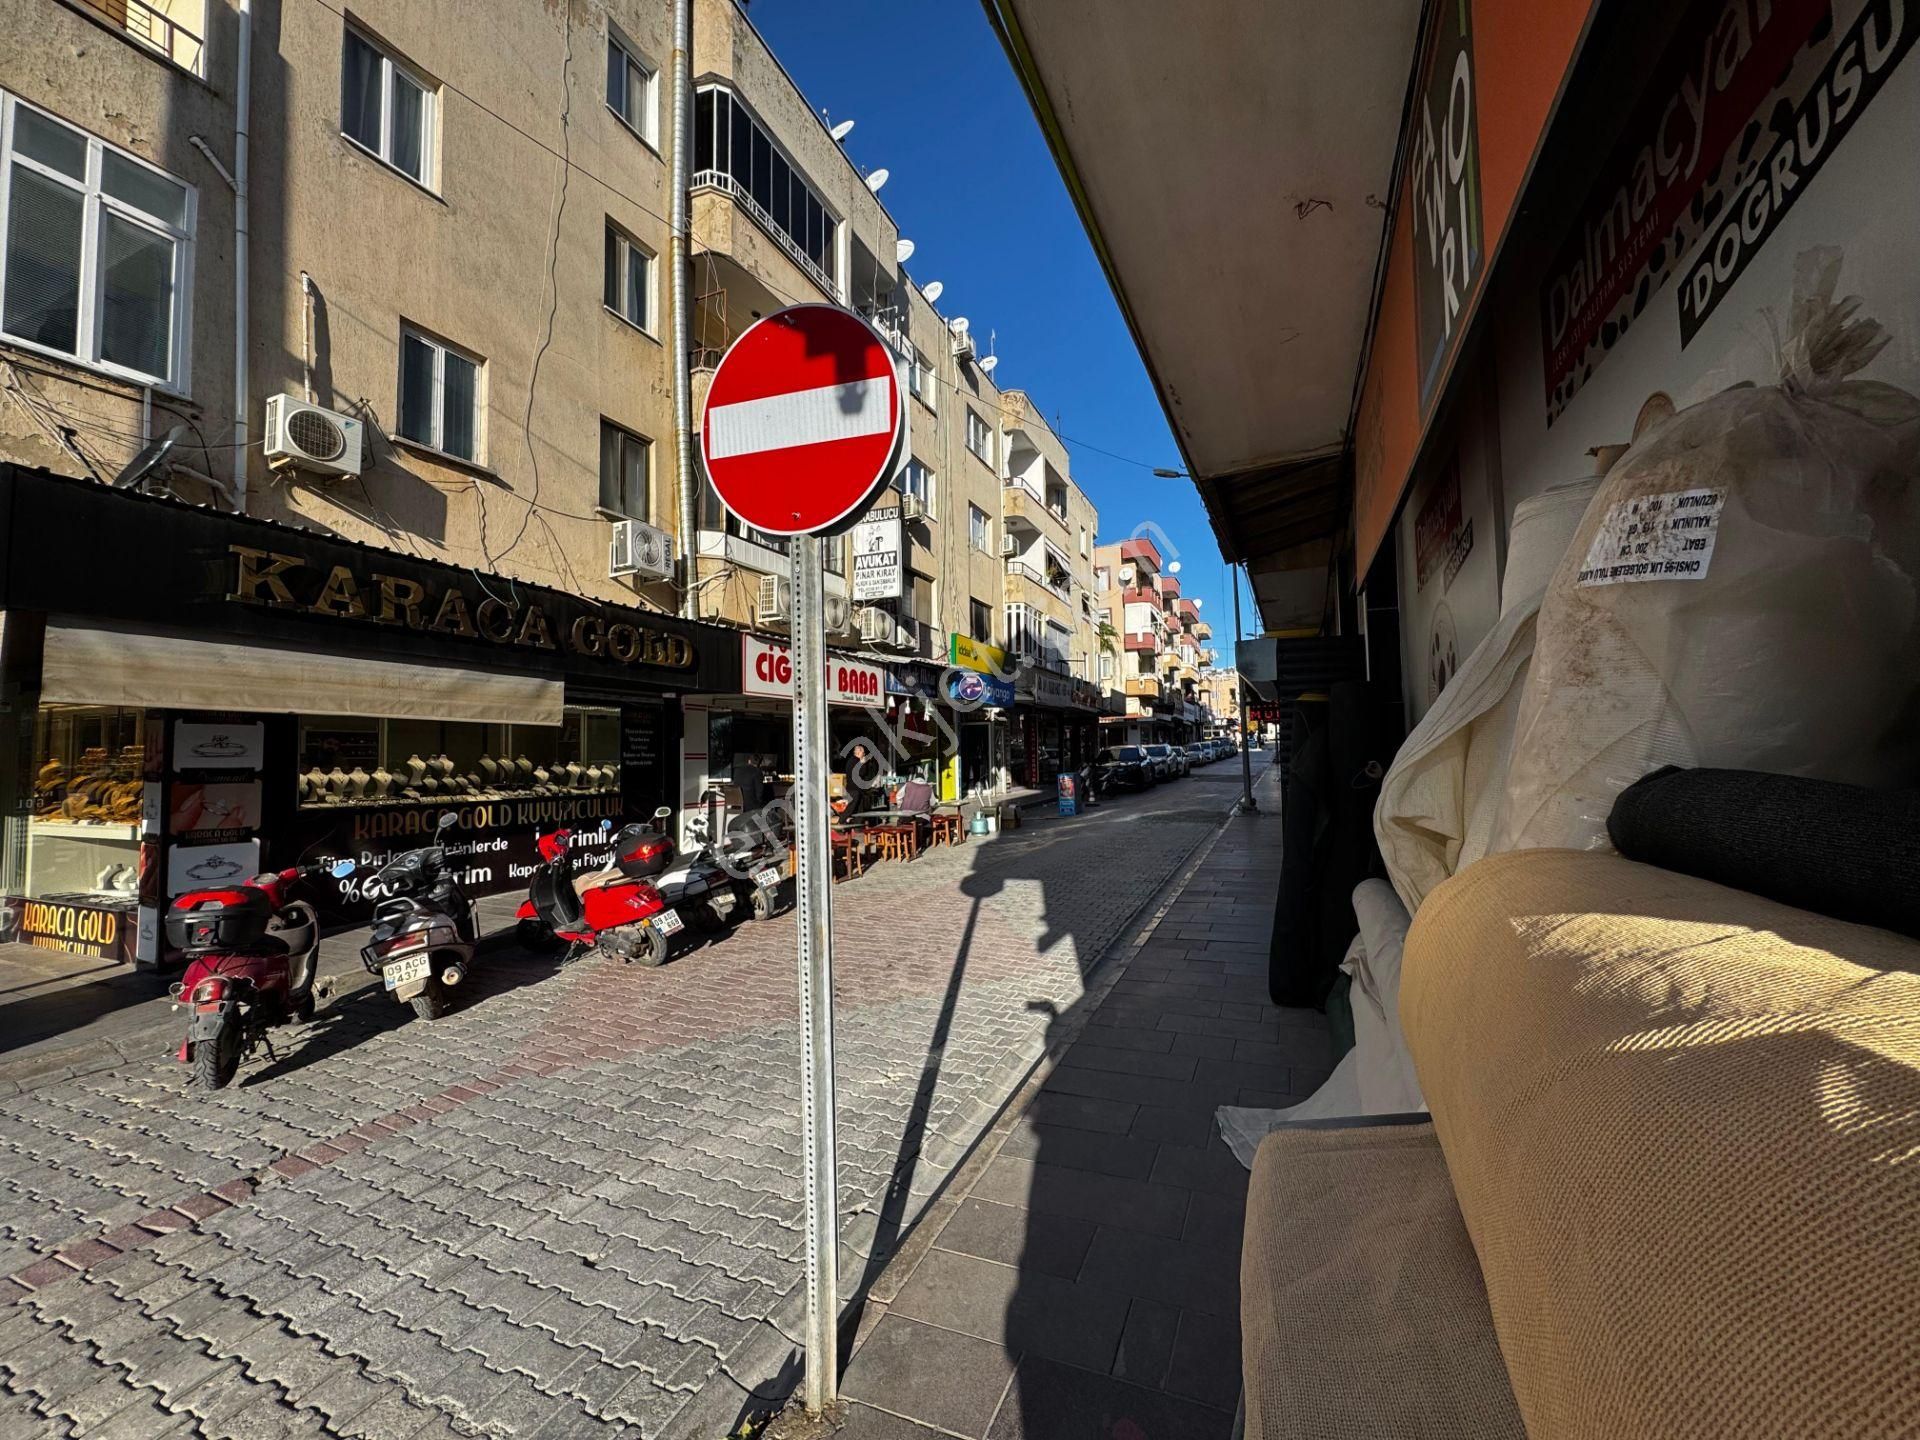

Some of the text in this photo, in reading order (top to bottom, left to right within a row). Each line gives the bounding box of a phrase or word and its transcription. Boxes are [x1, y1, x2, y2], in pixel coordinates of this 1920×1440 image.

[1682, 538, 1706, 551] EBAT
[855, 552, 896, 571] AVUKAT
[226, 543, 694, 669] KARACA GOLD
[838, 667, 878, 696] BABA
[458, 804, 512, 830] GOLD
[23, 902, 117, 946] KARACA GOLD
[386, 956, 427, 977] 09 ACG
[396, 970, 419, 985] 437
